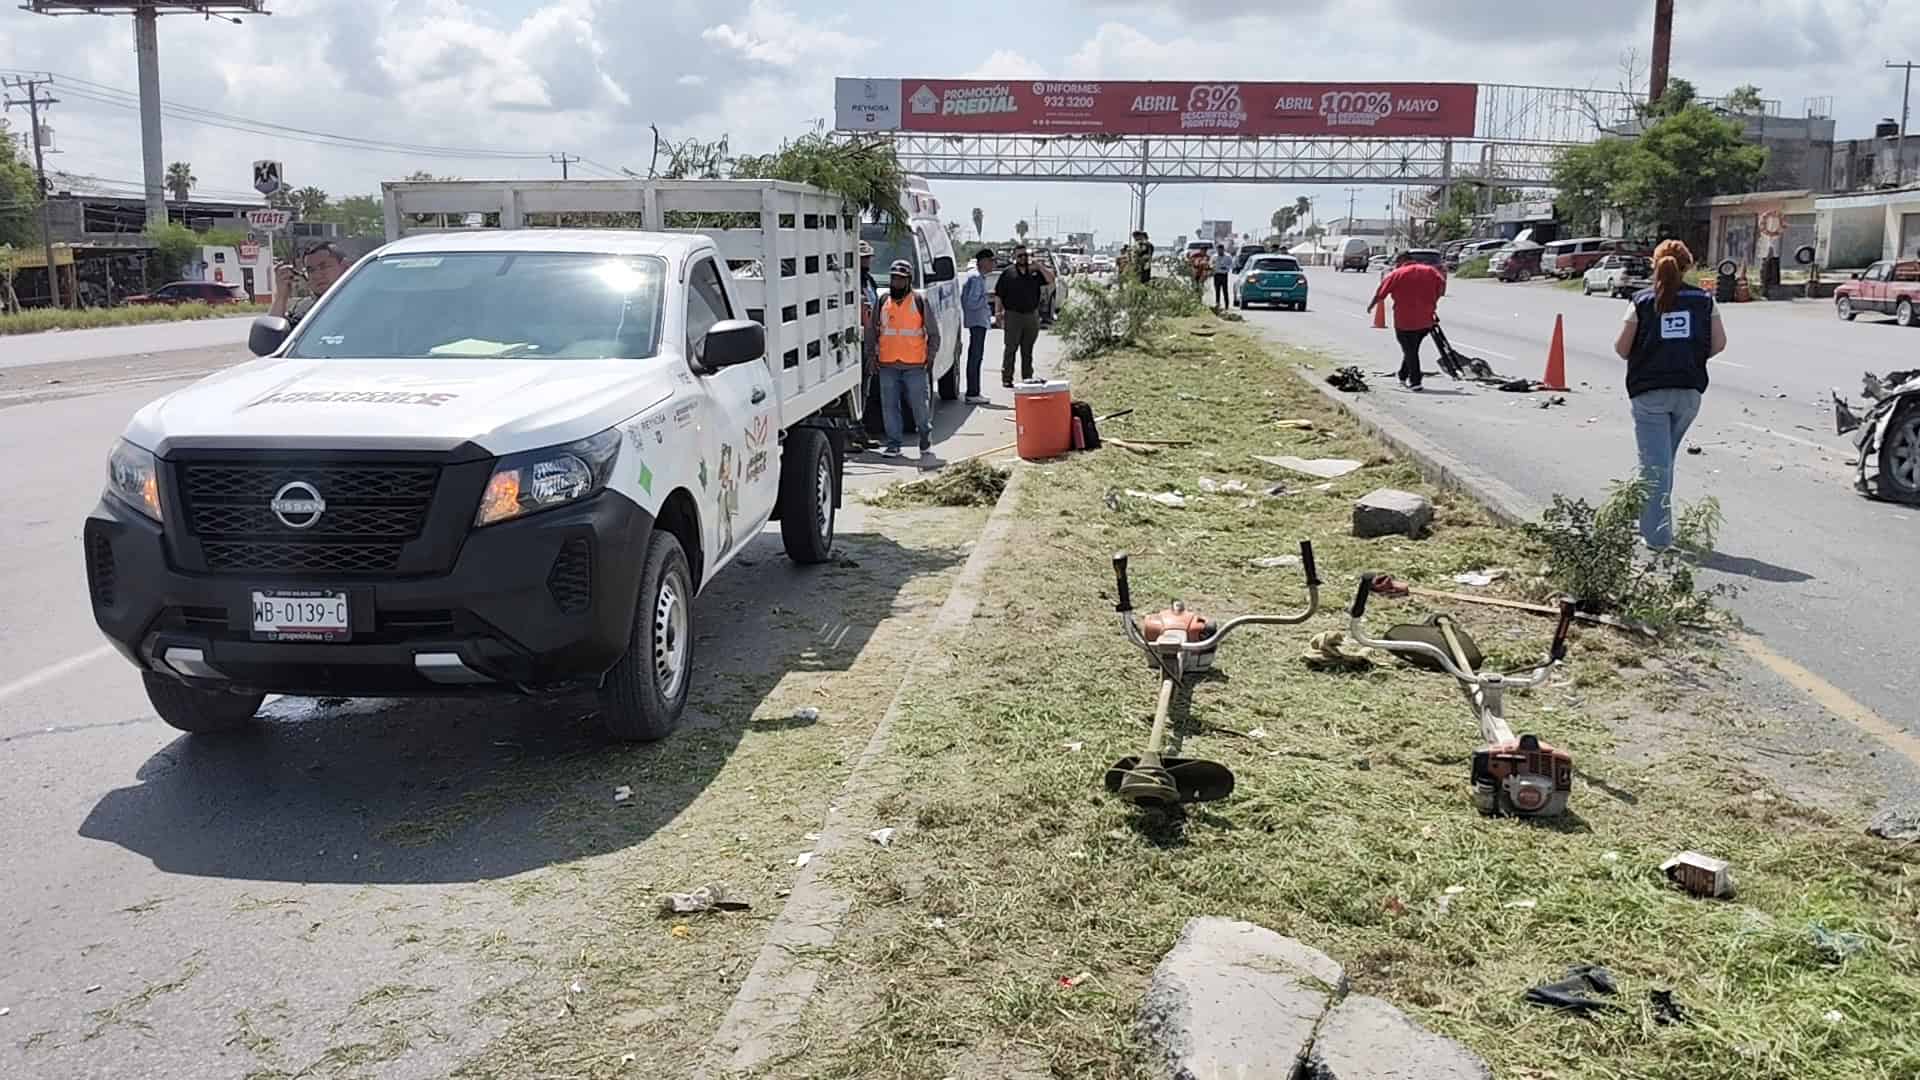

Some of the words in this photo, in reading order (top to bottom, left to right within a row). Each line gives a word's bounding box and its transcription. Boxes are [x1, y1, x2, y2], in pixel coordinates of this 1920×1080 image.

[944, 84, 1009, 99] PROMOCIÓN
[1046, 83, 1101, 94] INFORMES:
[942, 96, 1018, 116] PREDIAL
[1043, 96, 1064, 107] 932
[1066, 96, 1094, 107] 3200
[1131, 95, 1179, 111] ABRIL
[1187, 85, 1240, 113] 8%
[1275, 97, 1313, 111] ABRIL
[1319, 91, 1392, 117] 100%
[1397, 99, 1439, 112] MAYO
[851, 104, 890, 113] REYNOSA
[250, 212, 286, 225] TECATE
[271, 502, 326, 511] NISSAN
[254, 601, 346, 623] WB-0139-C
